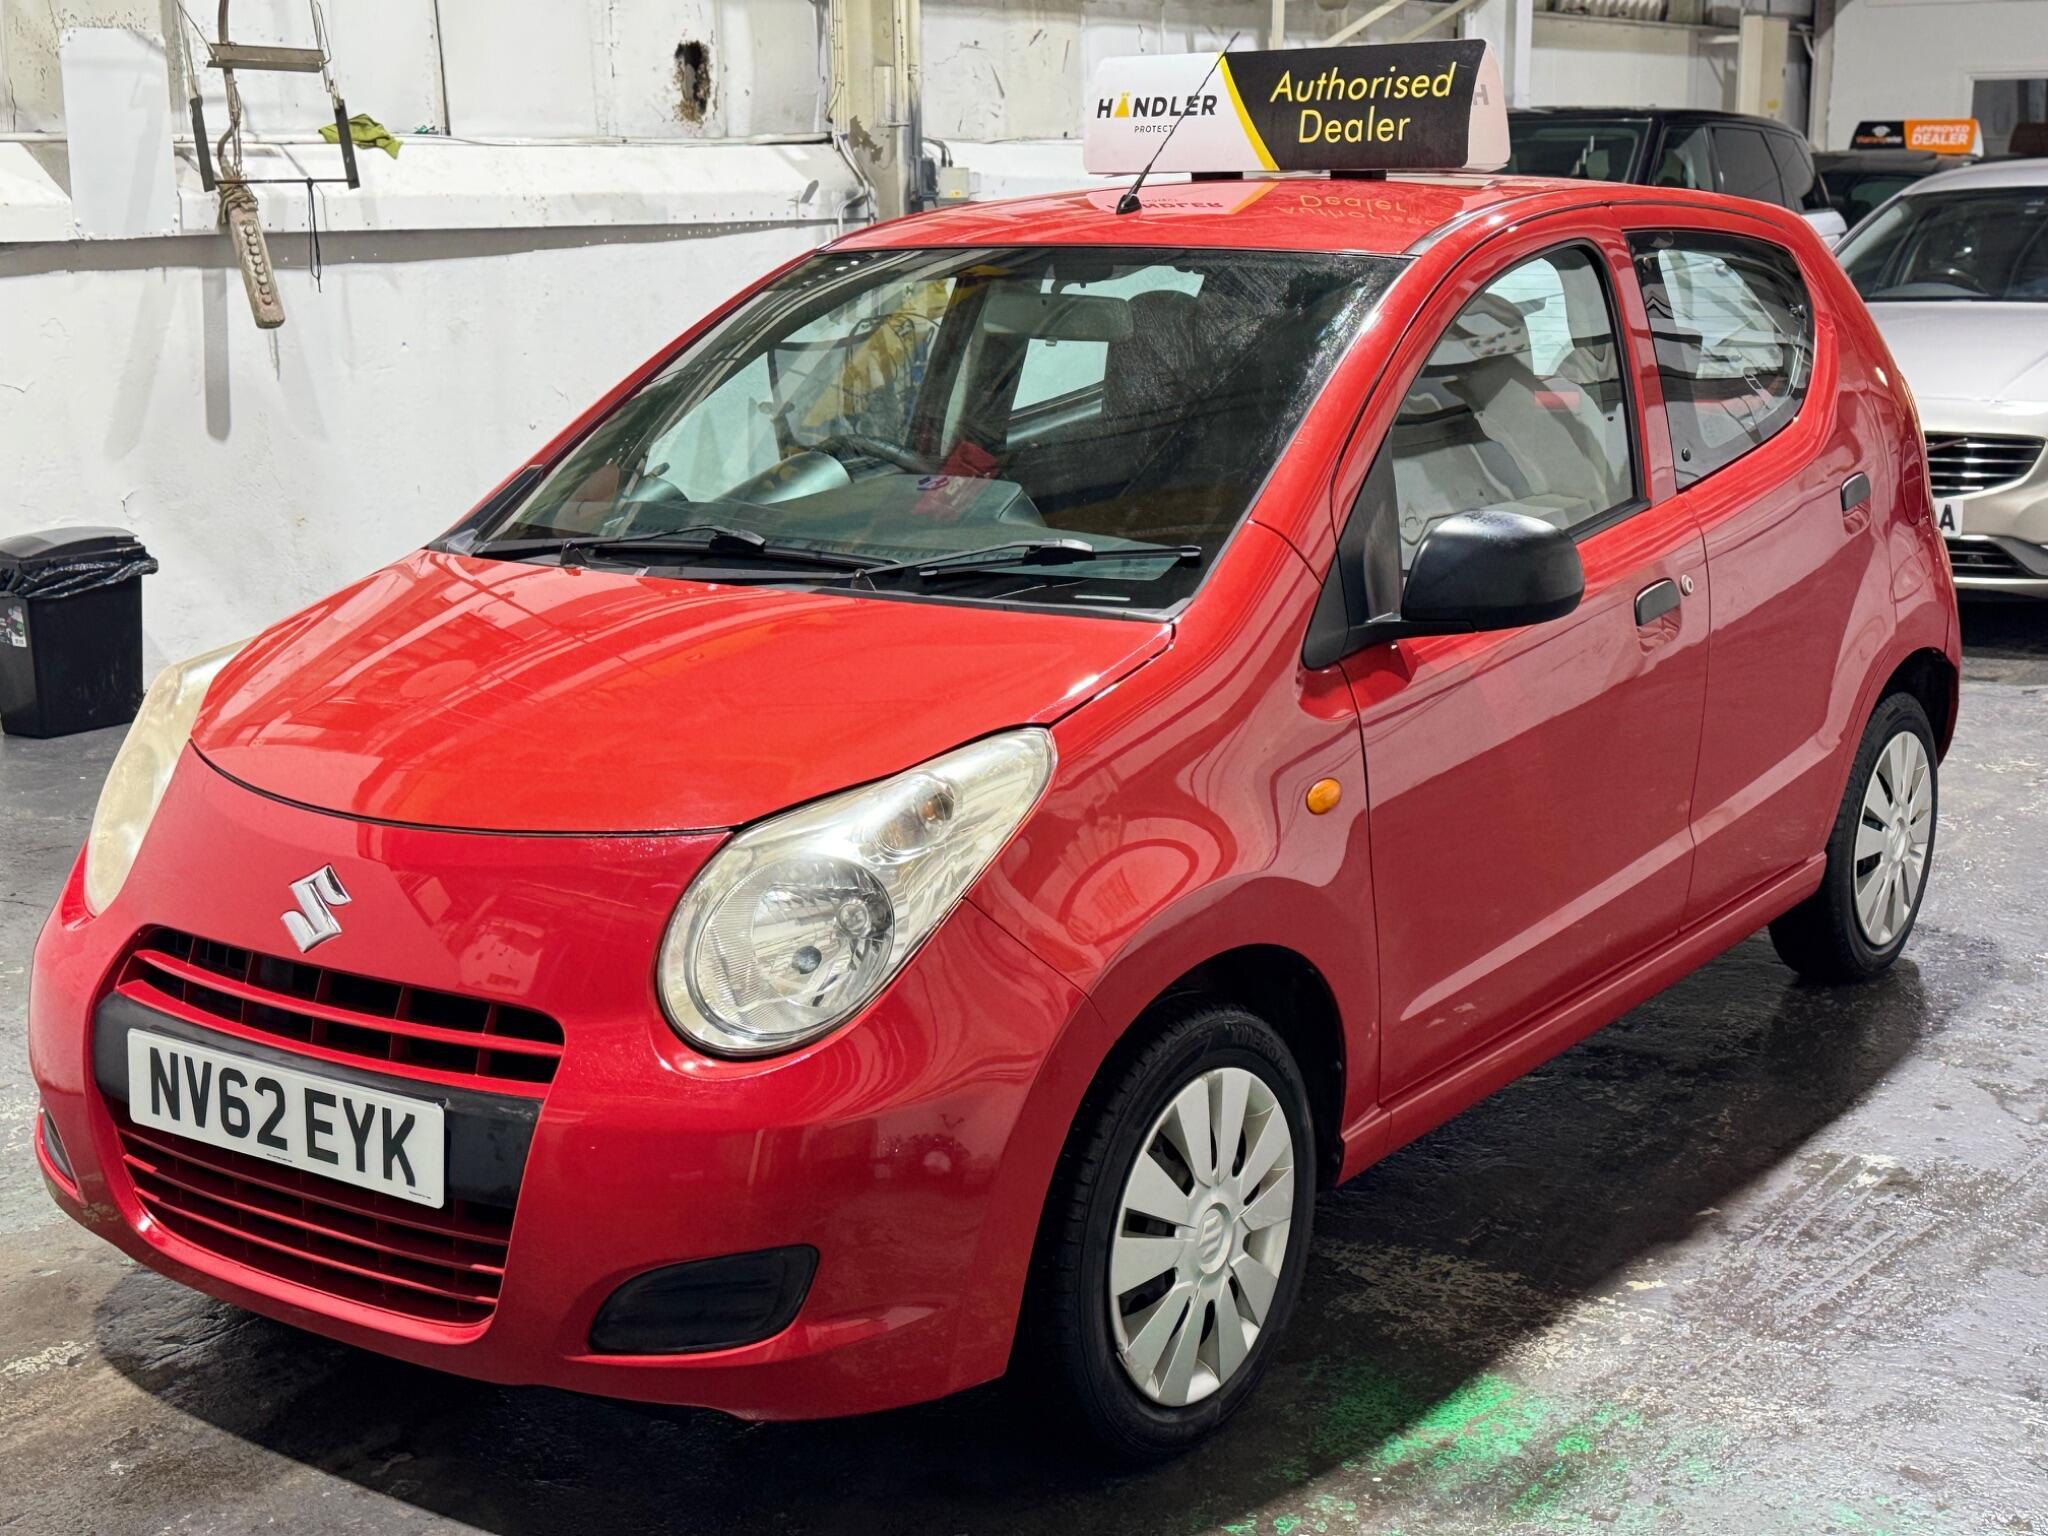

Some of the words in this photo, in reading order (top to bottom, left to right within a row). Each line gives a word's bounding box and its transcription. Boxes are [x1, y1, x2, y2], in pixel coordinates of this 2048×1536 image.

[1269, 61, 1457, 102] Authorised
[1134, 125, 1175, 133] PROTECT
[1298, 105, 1411, 143] Dealer
[1911, 133, 1969, 146] DEALER
[1938, 504, 1956, 531] A
[149, 1046, 288, 1151] NV62
[304, 1087, 416, 1188] EYK
